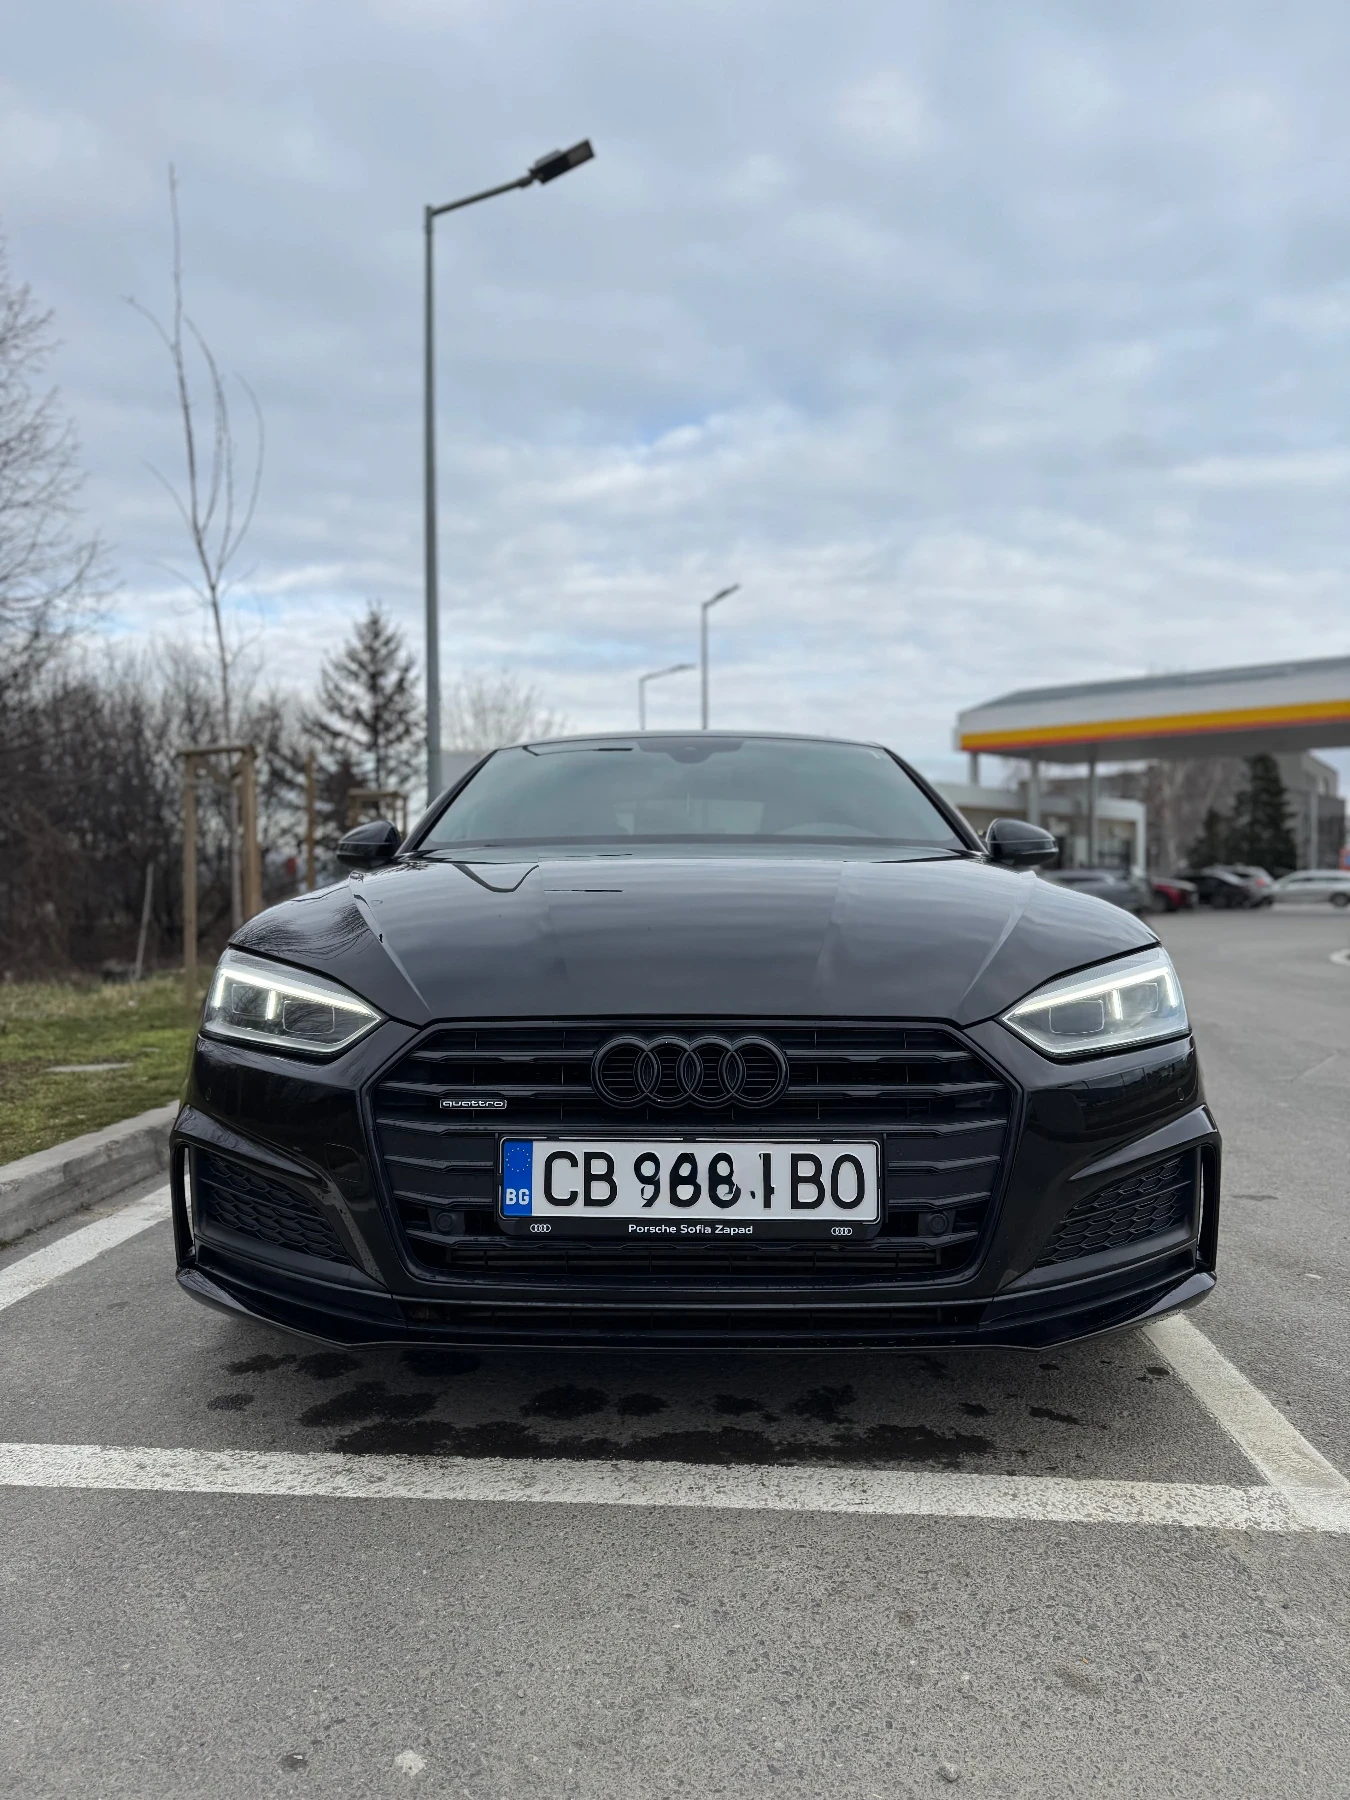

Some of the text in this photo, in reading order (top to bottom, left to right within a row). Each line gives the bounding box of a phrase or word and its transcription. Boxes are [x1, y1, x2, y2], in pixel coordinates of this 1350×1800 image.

[442, 1100, 504, 1108] quattro
[543, 1150, 618, 1207] CB
[505, 1188, 530, 1205] BG
[628, 1224, 754, 1236] Porsche Sofia Zapad
